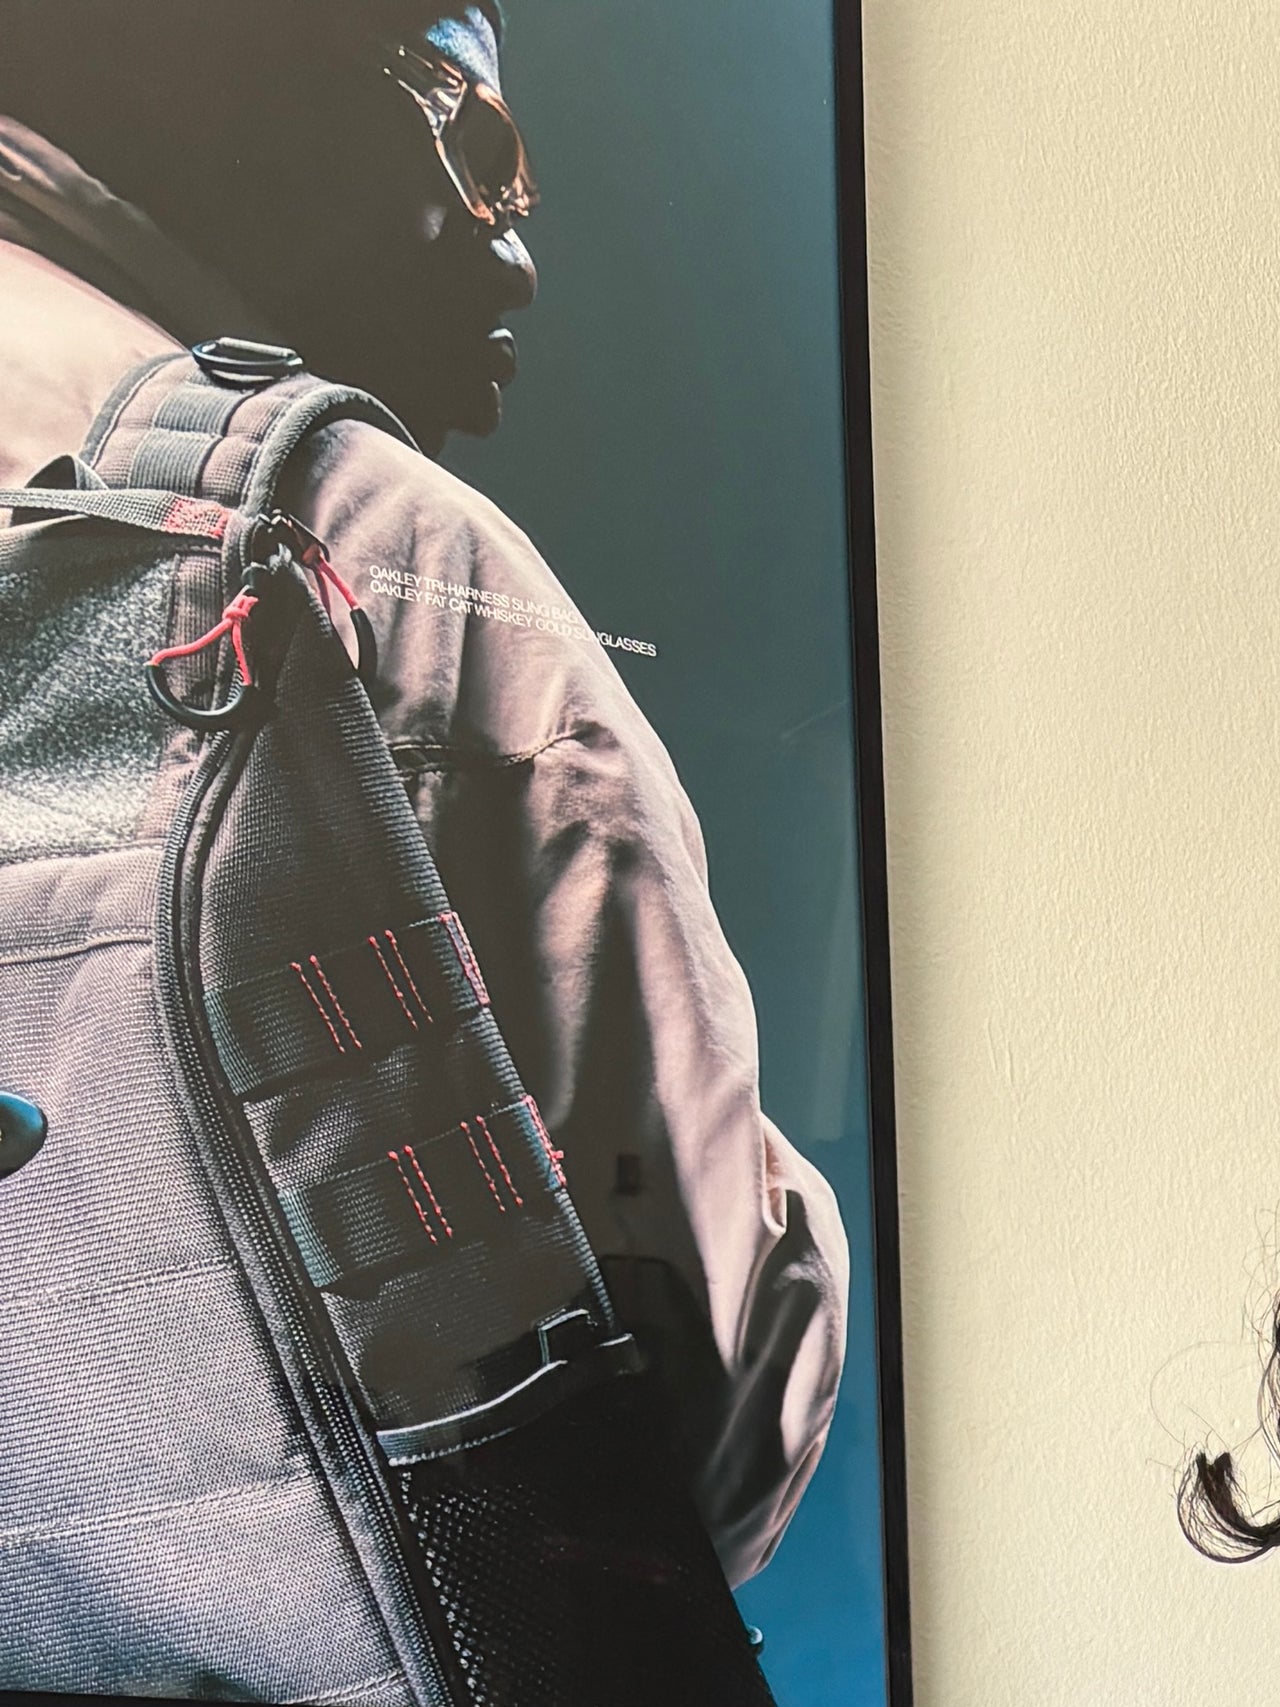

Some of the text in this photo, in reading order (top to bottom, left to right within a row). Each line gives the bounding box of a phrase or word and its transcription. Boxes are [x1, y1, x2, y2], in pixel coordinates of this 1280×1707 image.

[369, 564, 422, 587] OAKLEY
[424, 577, 510, 608] TRI-HARNESS
[512, 596, 550, 617] SLING
[370, 579, 423, 602] OAKLEY
[425, 592, 447, 609] FAT
[449, 598, 474, 614] CAT
[474, 604, 533, 628] WHISKEY
[535, 619, 572, 637] GOLD
